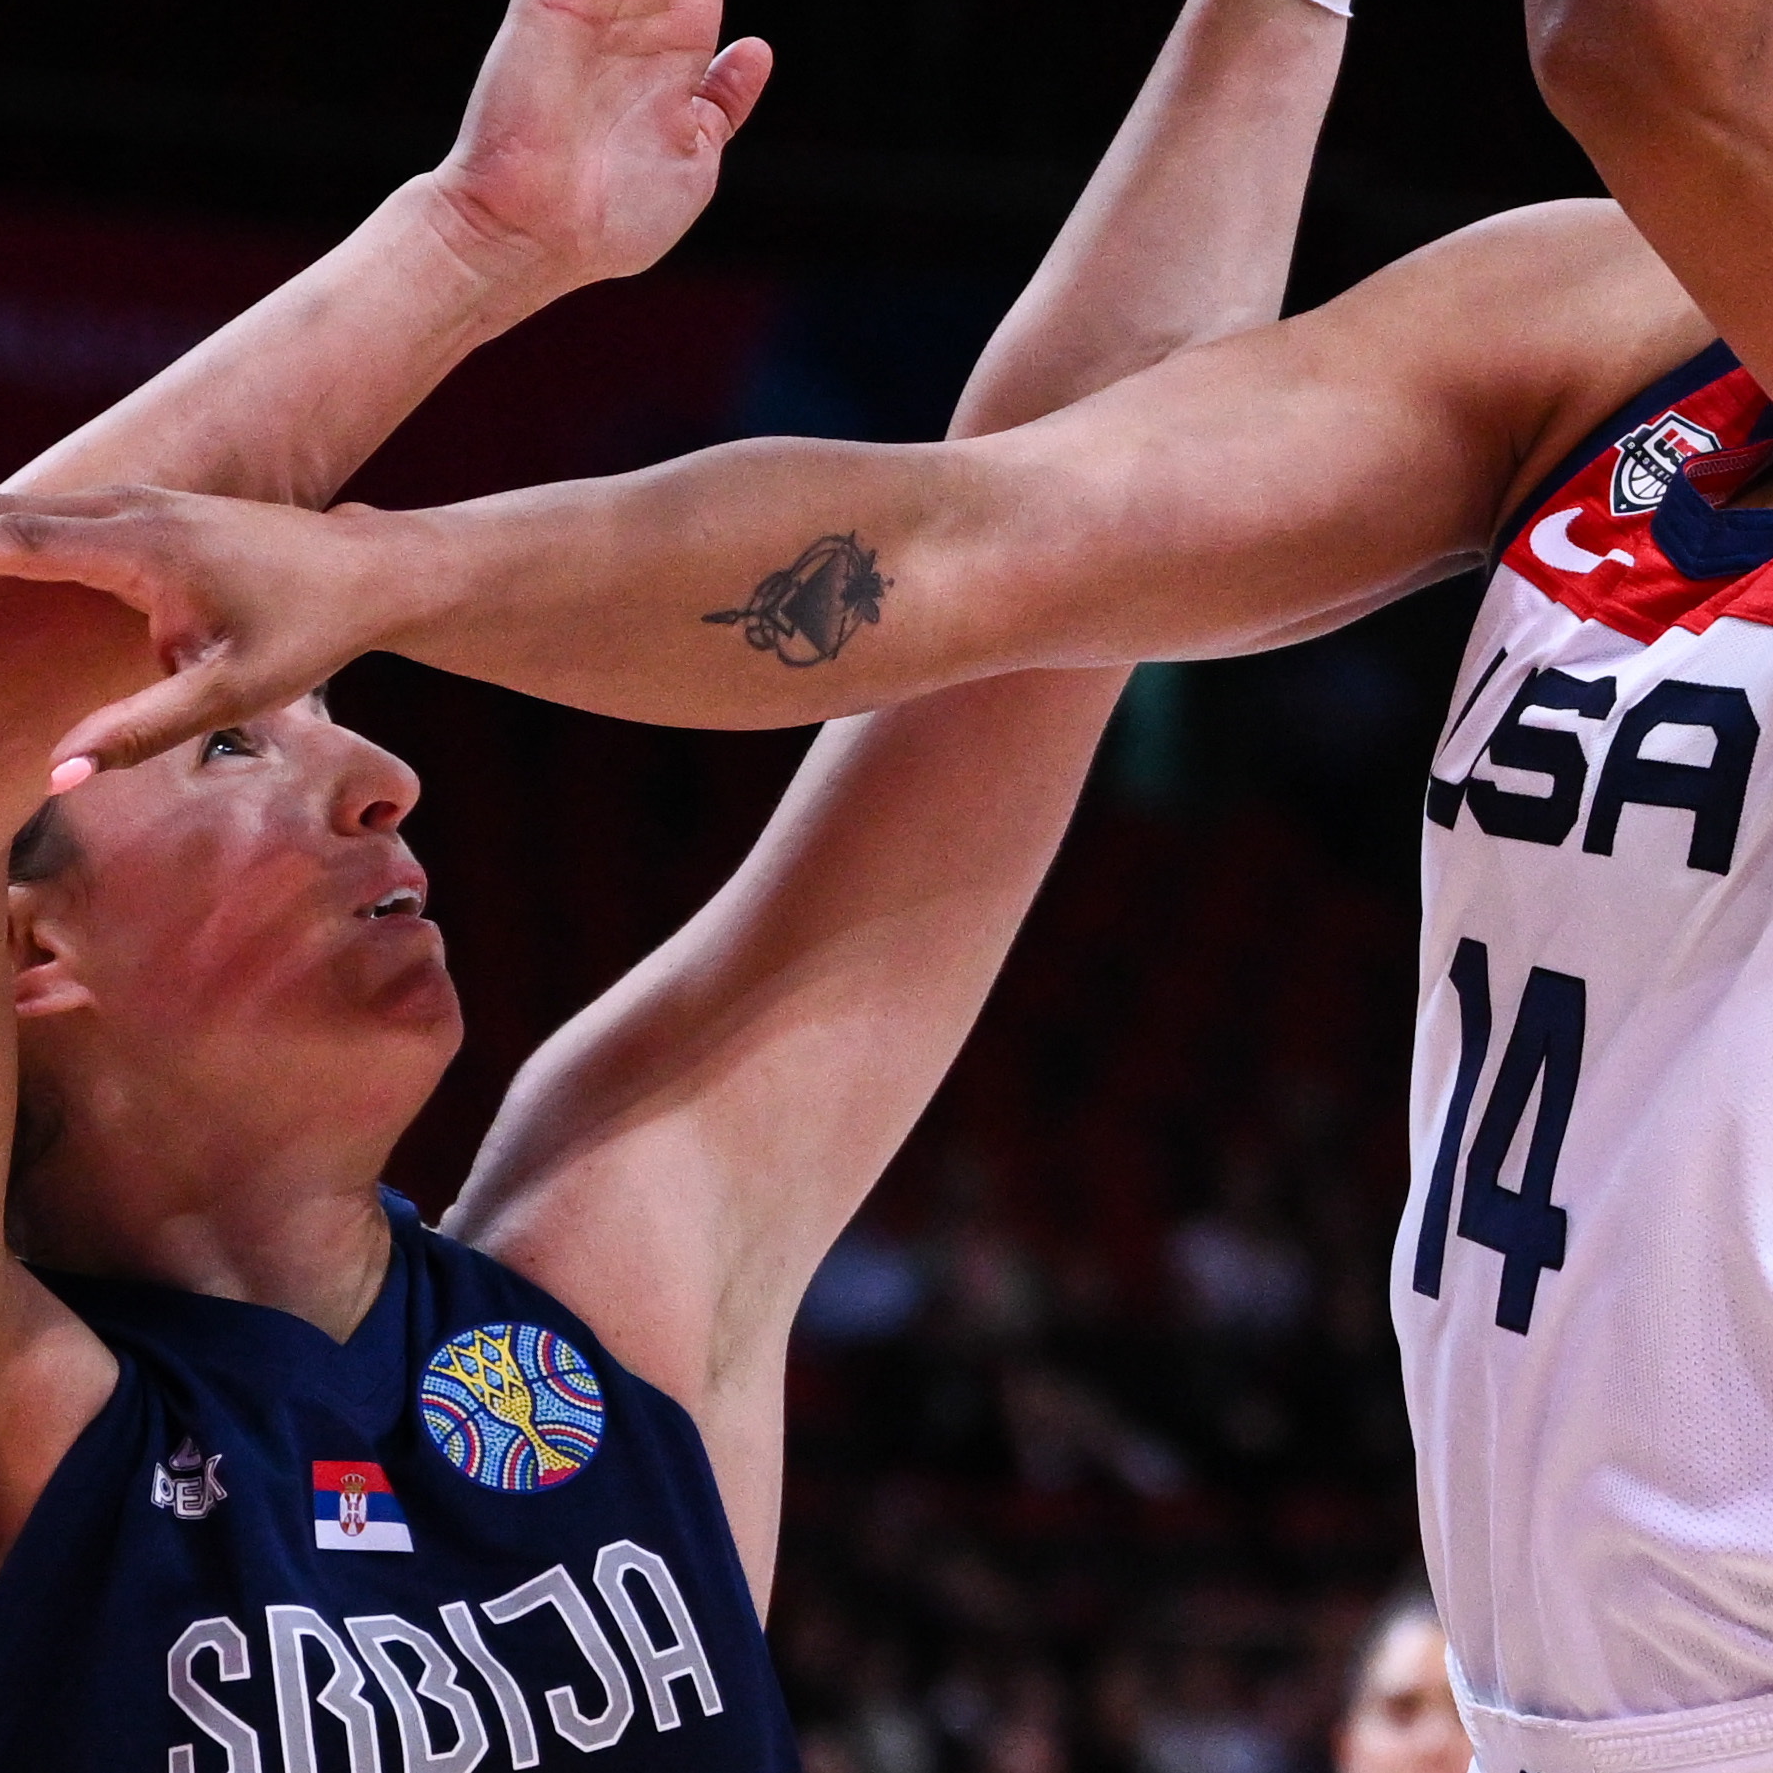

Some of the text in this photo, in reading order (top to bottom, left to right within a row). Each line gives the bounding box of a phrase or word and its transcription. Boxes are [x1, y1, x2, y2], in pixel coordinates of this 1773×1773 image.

[1425, 646, 1761, 876] USA
[1412, 936, 1587, 1336] 14
[166, 1538, 725, 1773] SRBIJA
